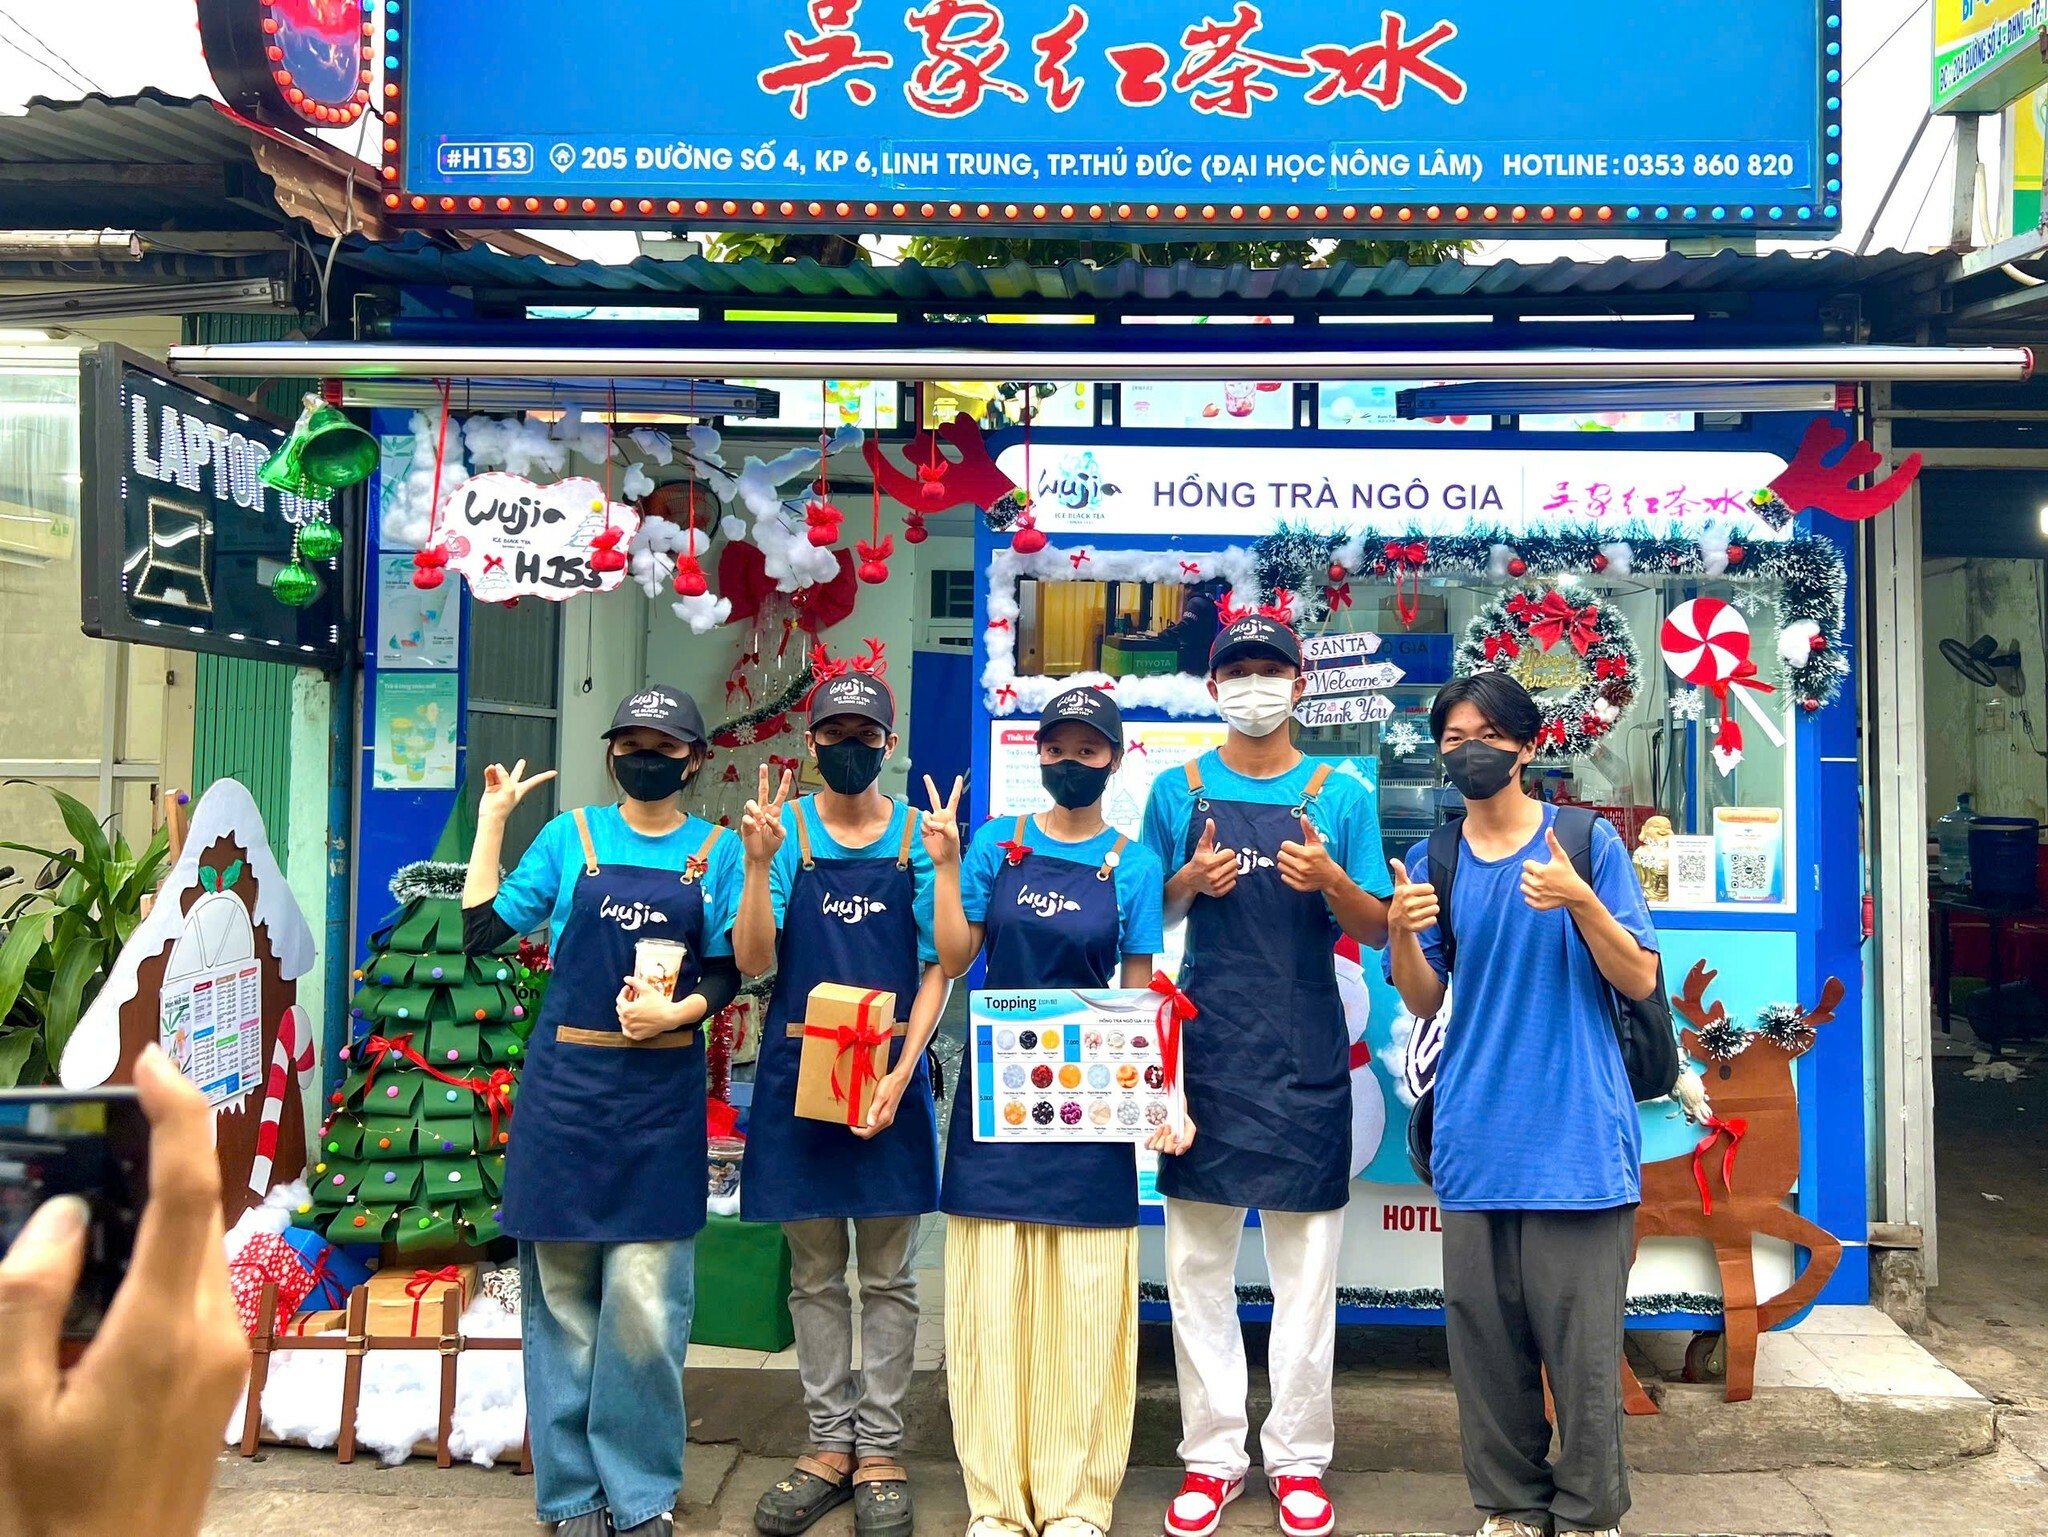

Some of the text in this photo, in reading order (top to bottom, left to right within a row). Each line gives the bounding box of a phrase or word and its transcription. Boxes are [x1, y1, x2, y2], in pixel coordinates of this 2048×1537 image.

[446, 149, 527, 169] #H153
[581, 147, 627, 170] 205
[635, 141, 733, 171] ĐƯỜNG
[740, 139, 777, 172] SỐ
[782, 150, 807, 175] 4,
[815, 150, 849, 173] KP
[855, 151, 878, 177] 6,
[882, 152, 939, 175] LINH
[946, 152, 1039, 179] TRUNG,
[1135, 147, 1193, 177] ĐỨC
[1201, 152, 1258, 183] (ĐẠI
[1266, 153, 1326, 183] HỌC
[1330, 147, 1410, 176] NÔNG
[1417, 147, 1483, 182] LÂM)
[1693, 154, 1740, 177] 860
[1747, 154, 1794, 177] 820
[1152, 472, 1504, 511] HỒNG TRÀ NGÔ GIA
[1310, 637, 1368, 656] SANTA
[1135, 659, 1171, 668] TOYOTA
[1306, 669, 1381, 692] Welcome
[1355, 694, 1388, 722] You
[984, 996, 1037, 1011] Topping
